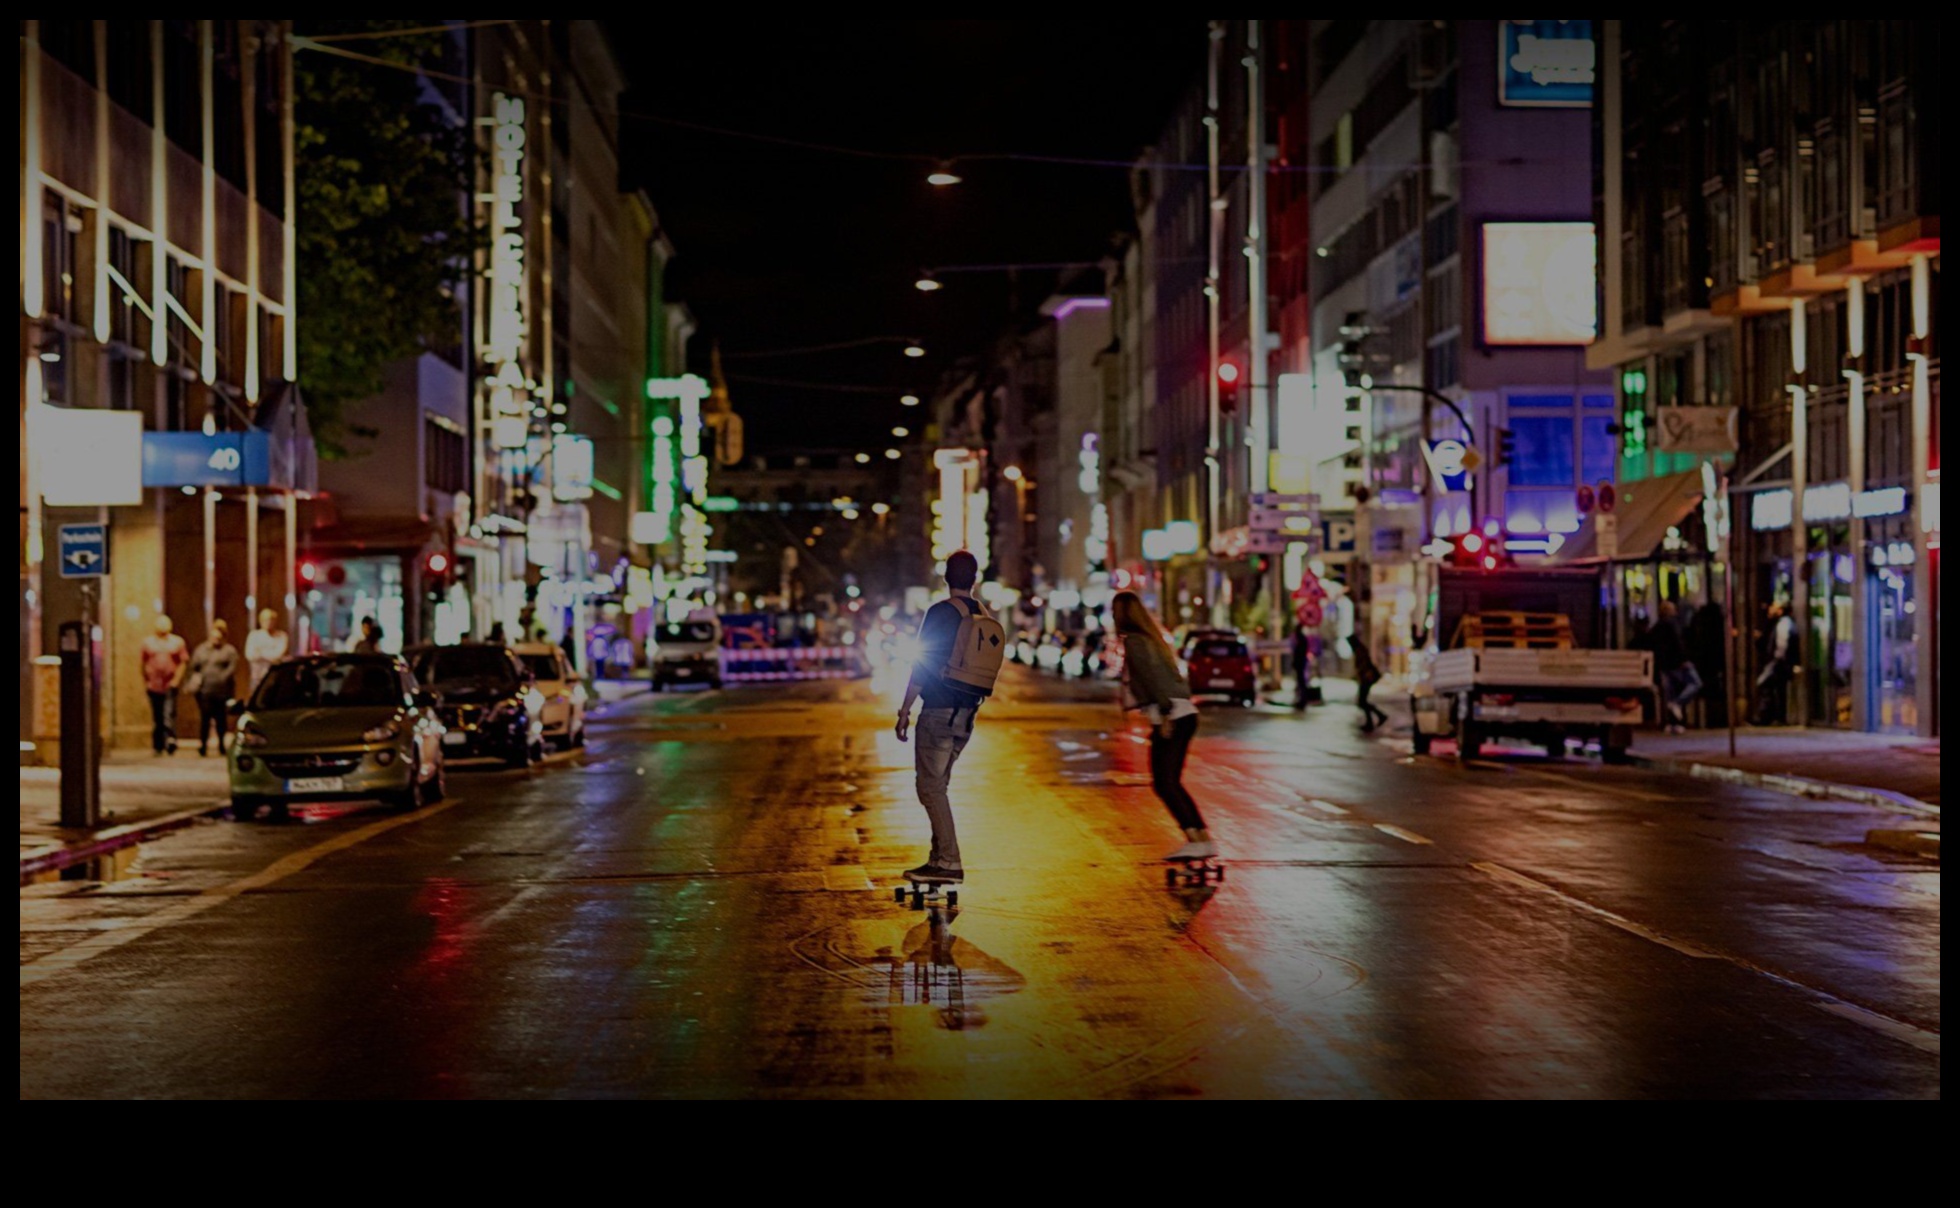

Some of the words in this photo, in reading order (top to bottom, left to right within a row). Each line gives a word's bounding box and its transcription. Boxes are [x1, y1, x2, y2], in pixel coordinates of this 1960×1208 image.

[496, 98, 525, 227] HOTEL
[207, 447, 240, 471] 40
[1329, 522, 1354, 550] P
